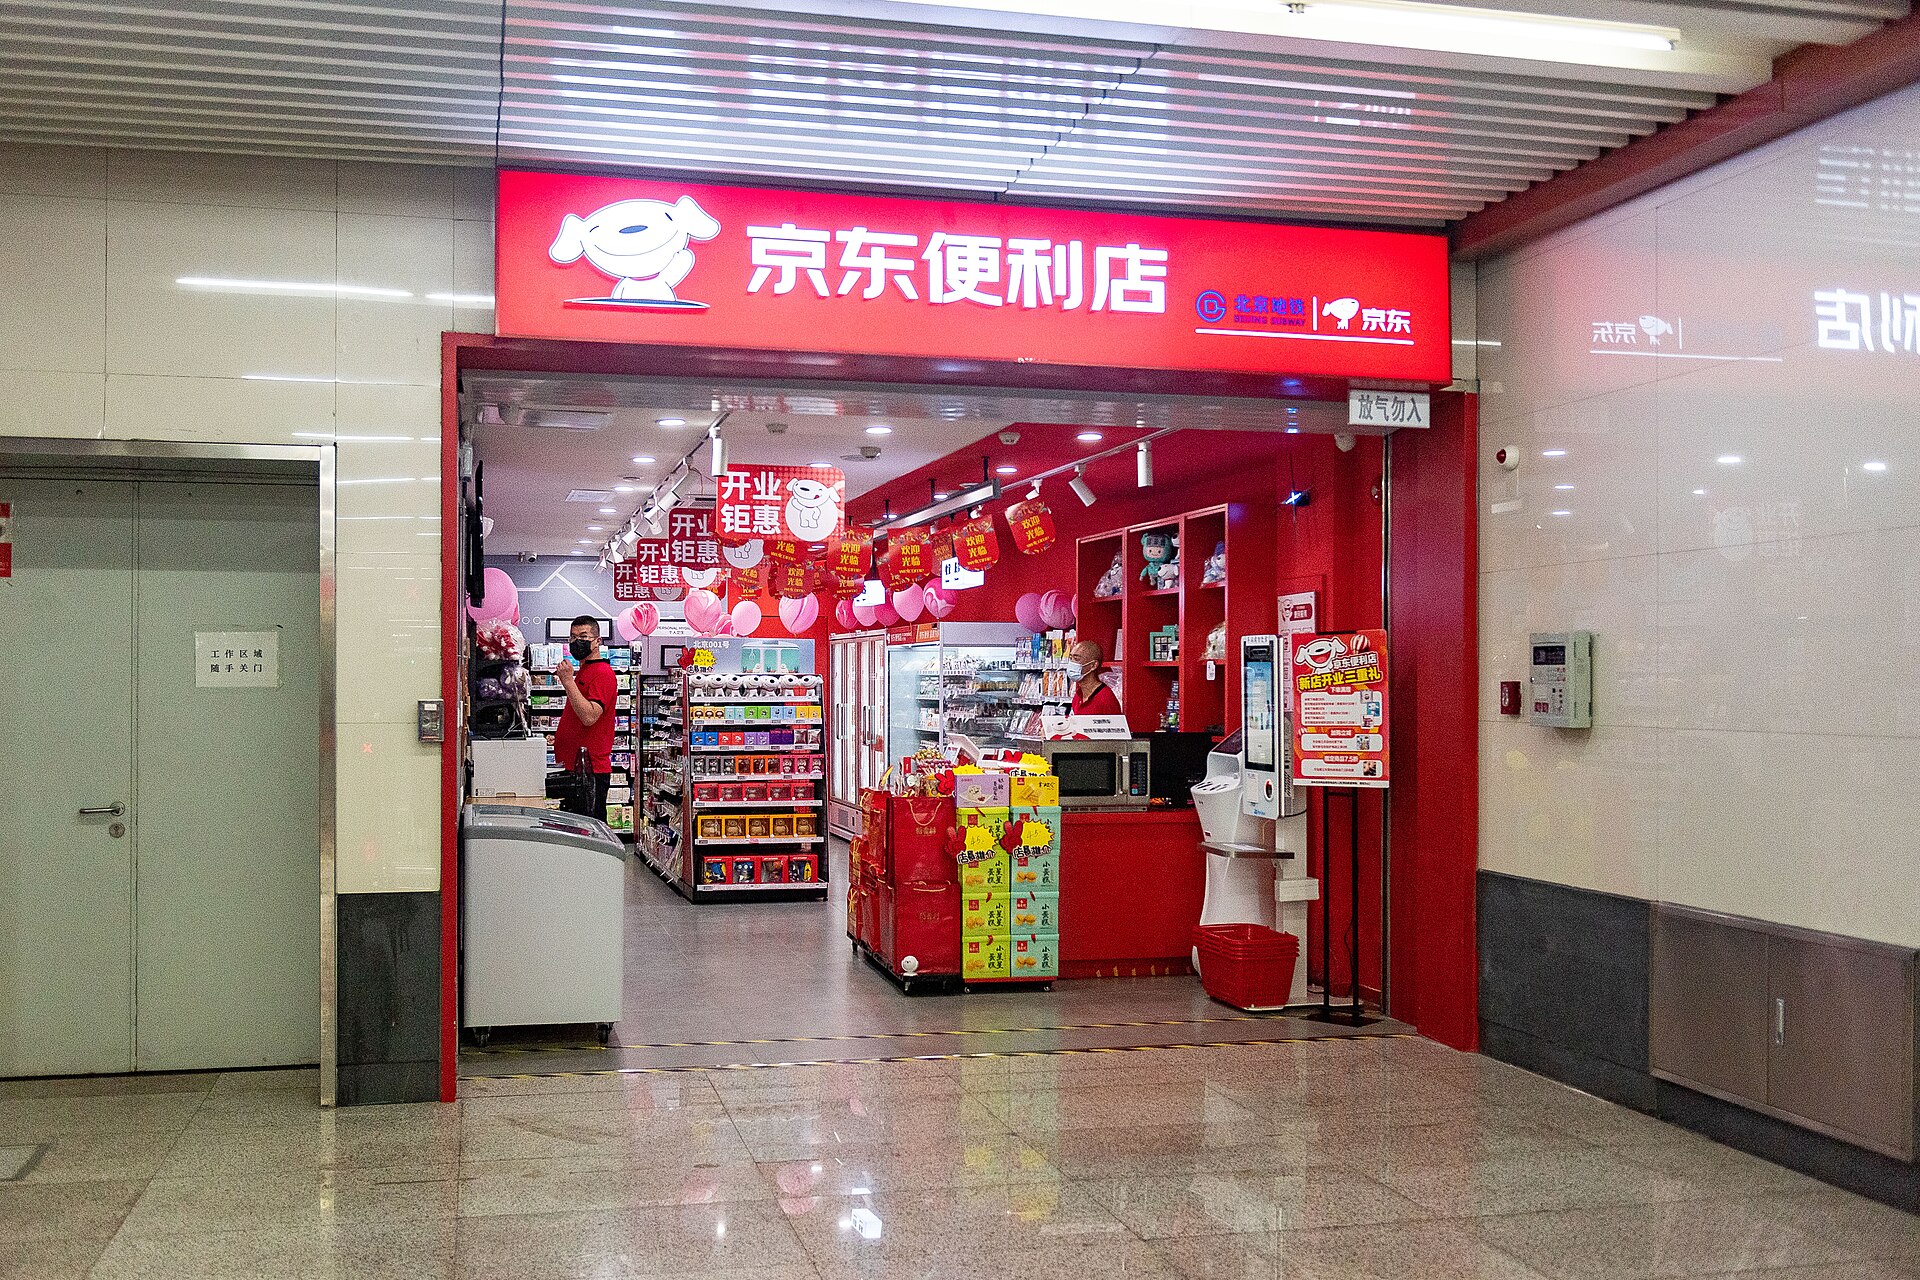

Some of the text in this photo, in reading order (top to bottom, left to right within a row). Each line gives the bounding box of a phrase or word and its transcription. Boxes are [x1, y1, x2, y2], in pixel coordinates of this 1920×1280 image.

[746, 223, 1168, 313] 京东便利店
[1234, 294, 1306, 316] 北京地铁
[1234, 315, 1306, 327] BEIJING SUBWAY
[1361, 308, 1411, 334] 京东
[1357, 394, 1422, 423] 放气勿入
[721, 471, 782, 501] 开业
[720, 503, 781, 535] 钜惠
[671, 539, 719, 564] 钜惠
[640, 564, 680, 584] 钜惠
[210, 649, 263, 659] 工作区域
[693, 641, 730, 649] 北京001号
[210, 663, 263, 673] 随手关门
[1333, 654, 1377, 669] 京东便利店
[1299, 667, 1380, 690] 新店开业三重礼
